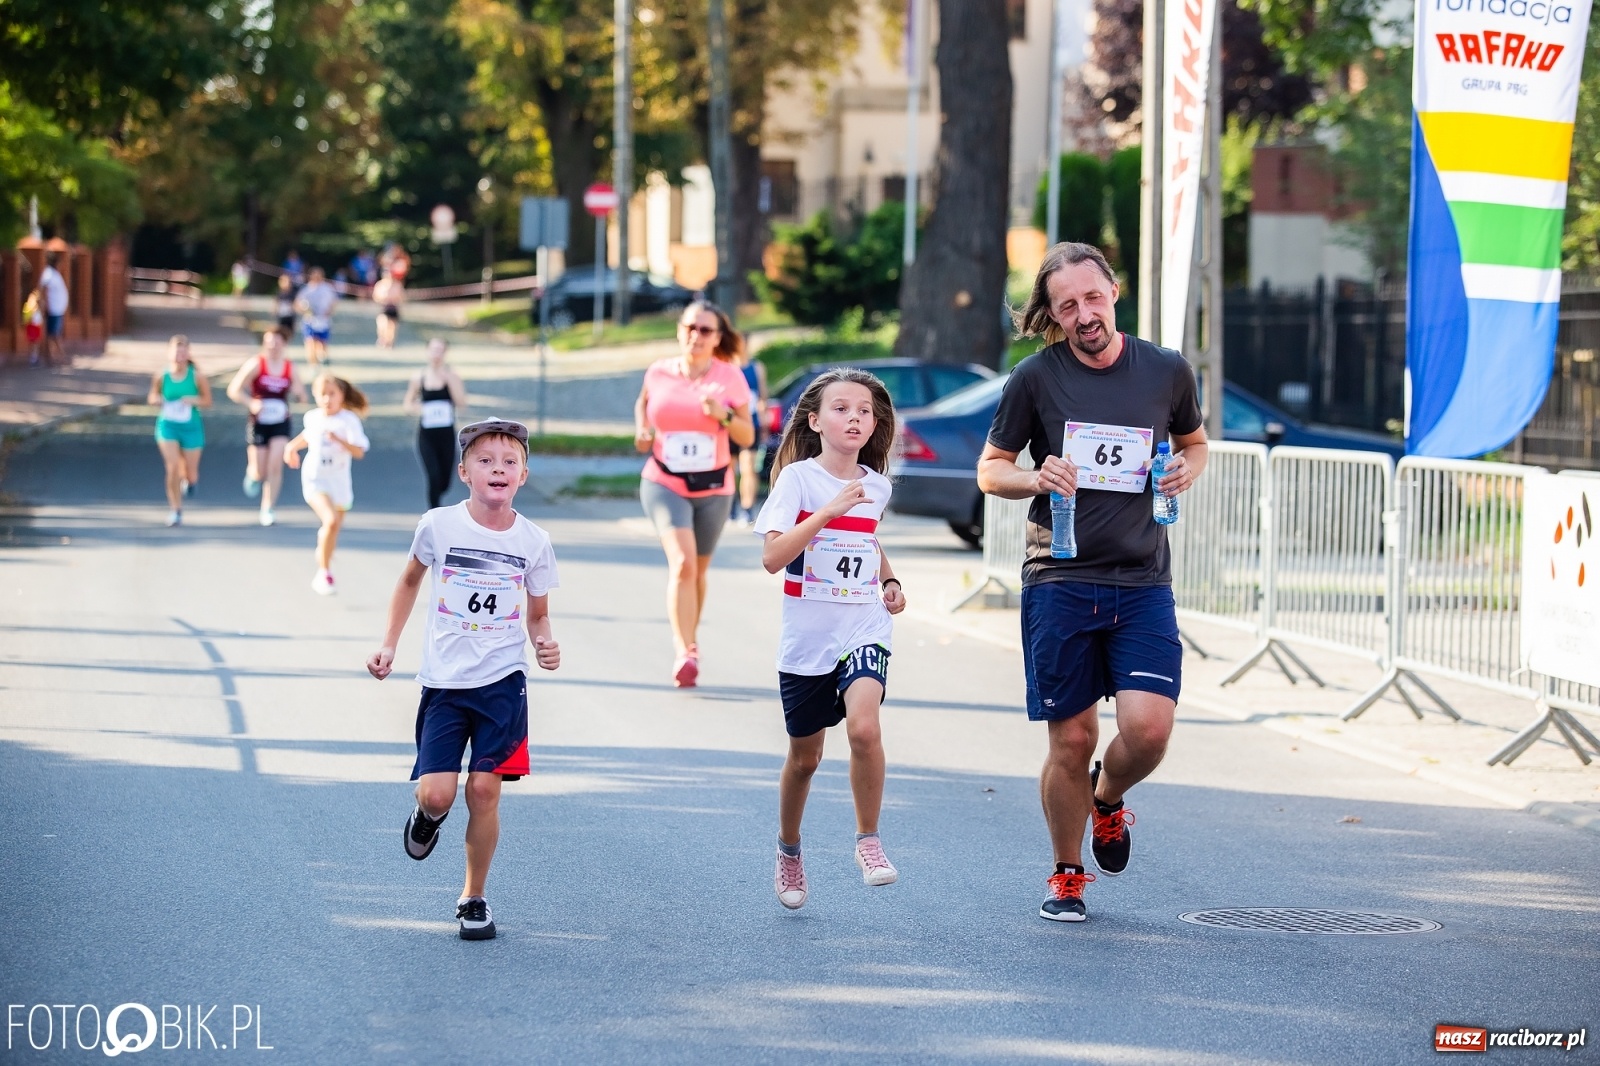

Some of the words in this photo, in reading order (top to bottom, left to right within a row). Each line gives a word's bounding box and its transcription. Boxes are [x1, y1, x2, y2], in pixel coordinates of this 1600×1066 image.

[1435, 30, 1565, 72] RAFAKO
[1094, 443, 1123, 467] 65
[835, 556, 863, 579] 47
[467, 592, 498, 615] 64
